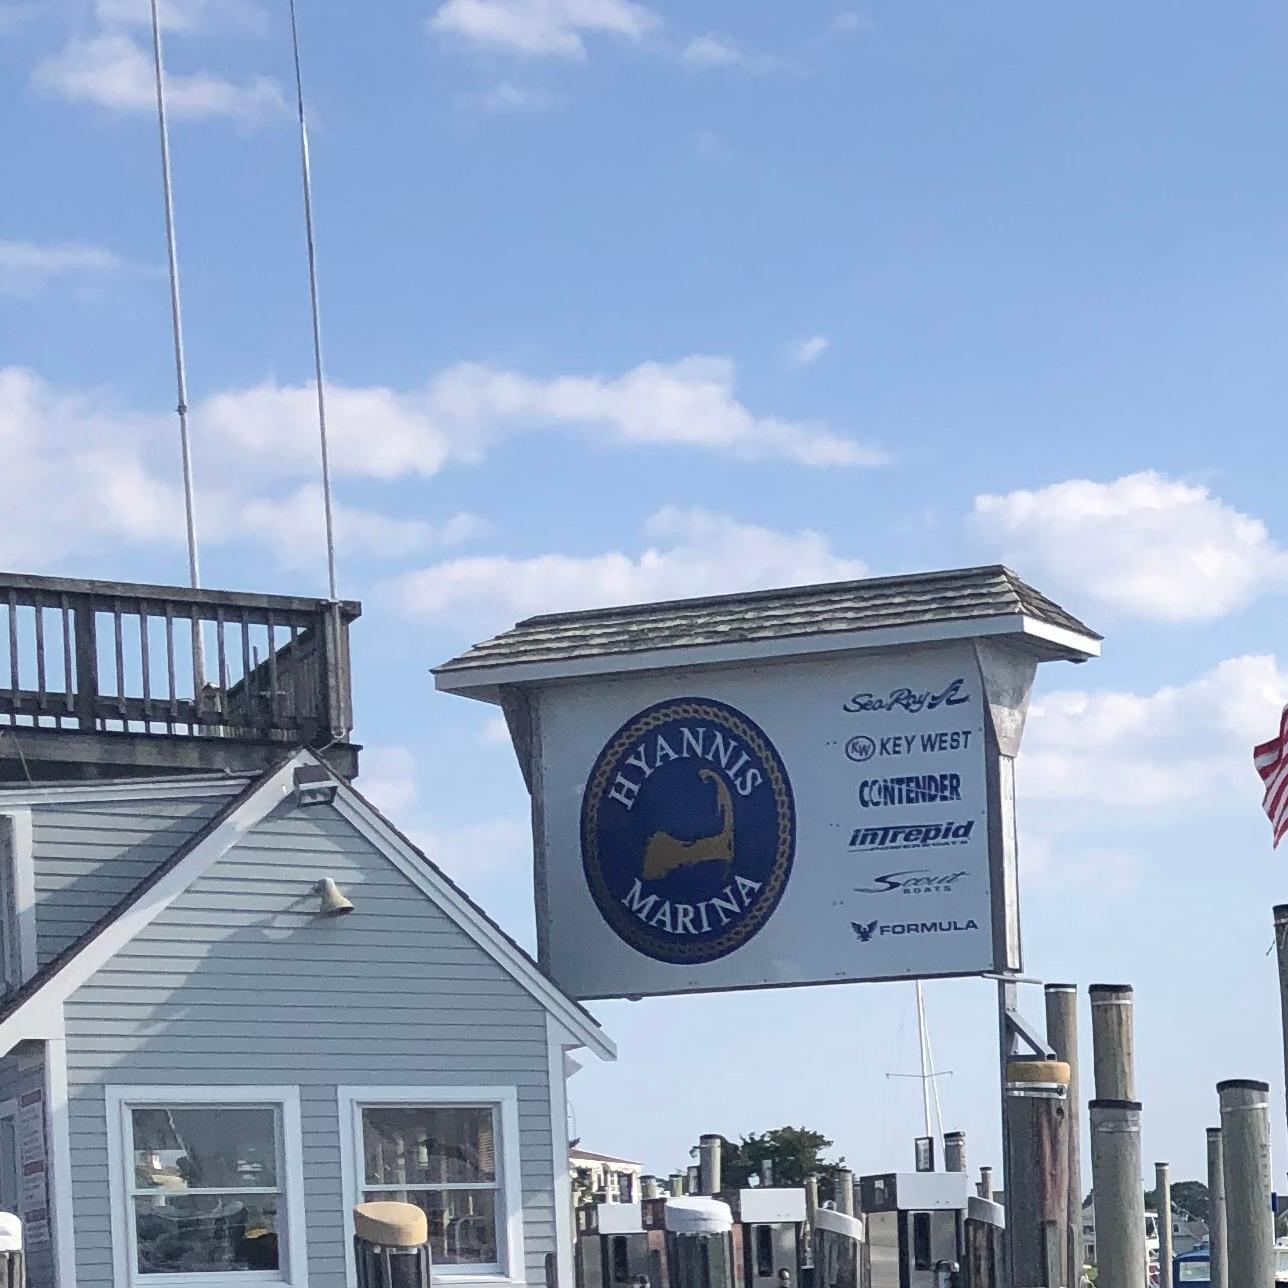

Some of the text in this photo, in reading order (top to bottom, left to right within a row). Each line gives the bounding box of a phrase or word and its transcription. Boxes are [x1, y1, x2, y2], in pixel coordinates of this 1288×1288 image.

[842, 688, 930, 713] Sea Ray
[879, 735, 917, 757] KEY
[920, 730, 972, 753] WEST
[608, 727, 764, 811] HYANNIS
[858, 773, 962, 808] CONTENDER
[903, 885, 952, 894] BOATS
[621, 875, 763, 935] MARINA
[879, 919, 979, 936] FORMULA
